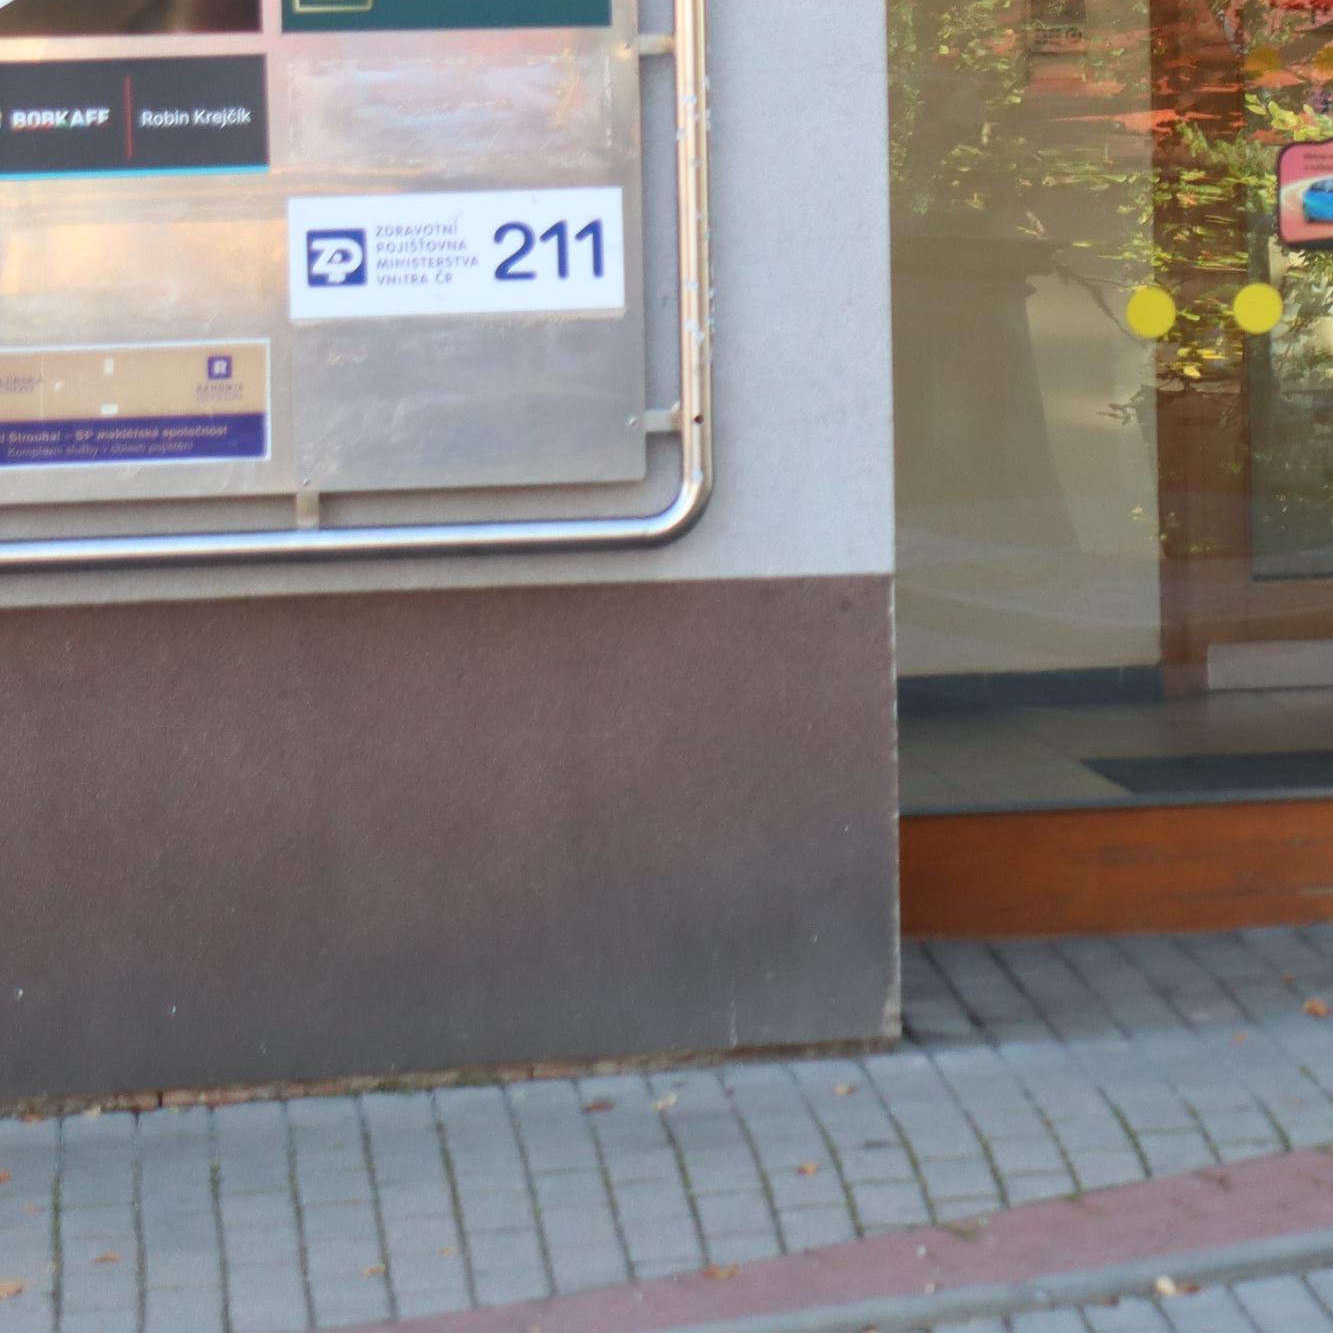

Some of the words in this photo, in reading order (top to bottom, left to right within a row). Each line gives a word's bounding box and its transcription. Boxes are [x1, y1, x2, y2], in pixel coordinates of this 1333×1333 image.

[142, 109, 189, 127] Robin
[194, 106, 251, 129] Krejčík
[375, 220, 458, 238] ZDRAVOTNÍ
[376, 238, 467, 253] POJIŠŤOVNA
[493, 218, 604, 280] 211
[376, 255, 480, 270] MINISTERSTVA
[377, 273, 429, 286] VNITRA
[435, 270, 453, 284] ČR
